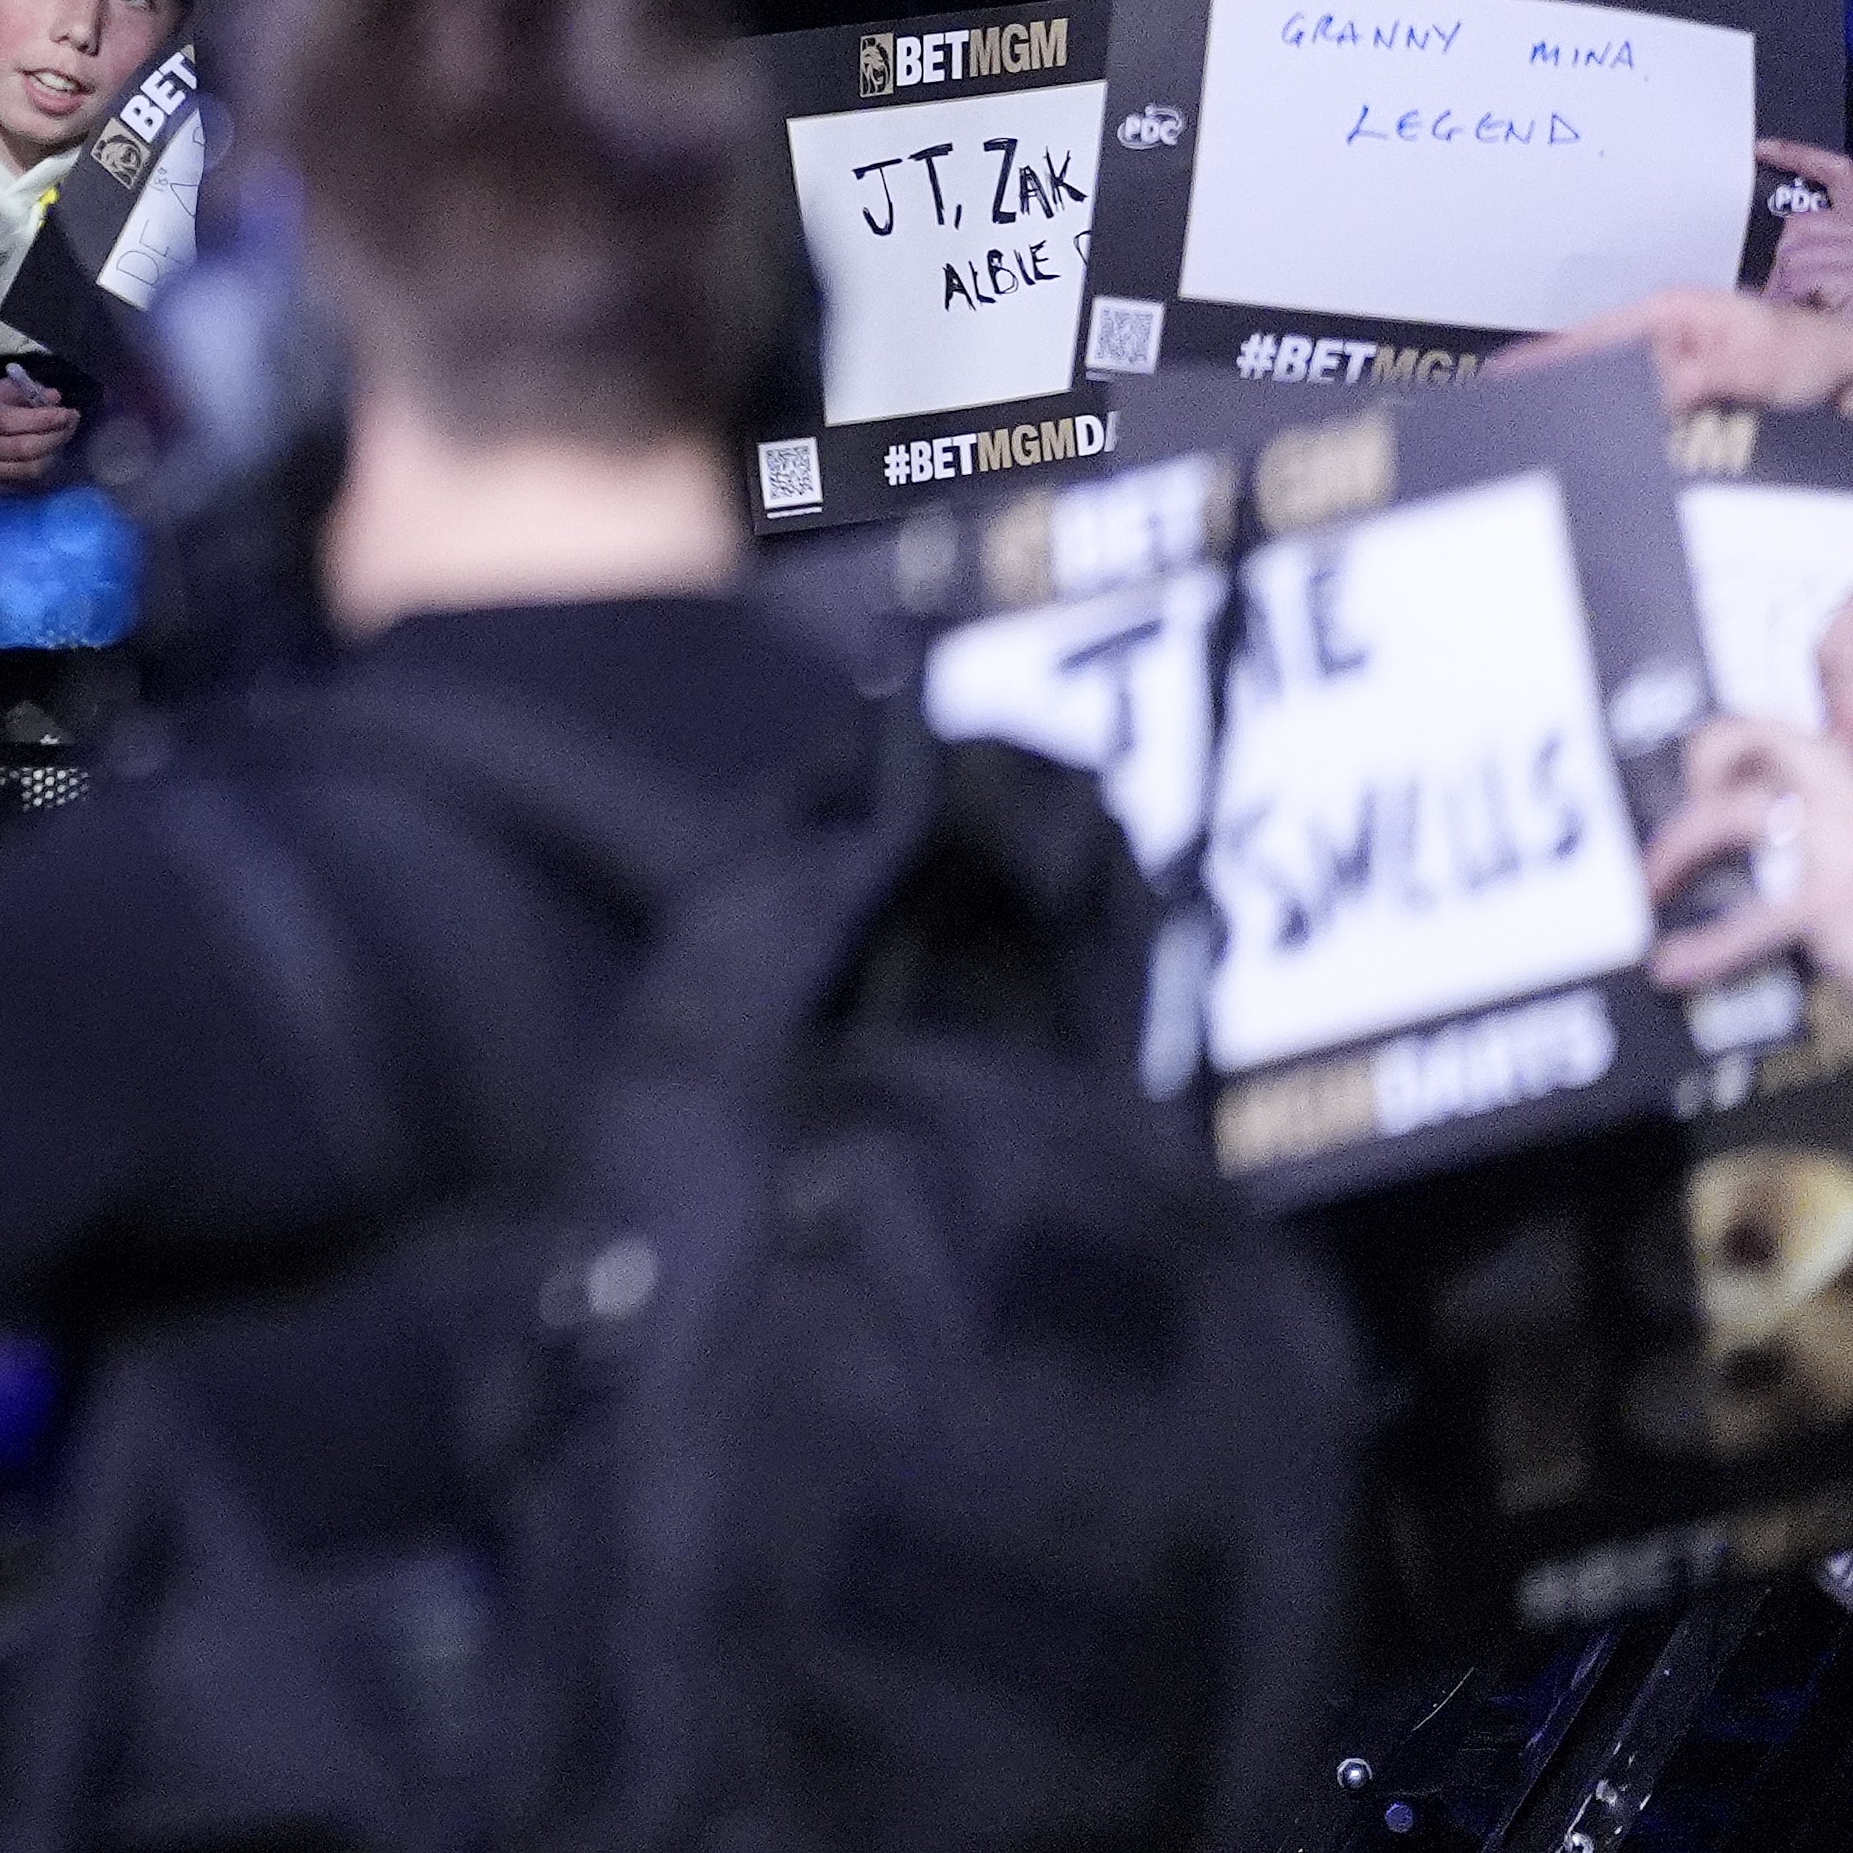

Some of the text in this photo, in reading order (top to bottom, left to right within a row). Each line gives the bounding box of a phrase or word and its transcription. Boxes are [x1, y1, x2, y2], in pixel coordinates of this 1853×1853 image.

[894, 16, 1071, 89] BETMGM
[1280, 12, 1464, 57] GRANNY
[119, 43, 198, 144] BET
[1115, 102, 1189, 150] PDC
[1235, 332, 1496, 389] #BETMGM
[883, 410, 1119, 488] #BETMGMDA
